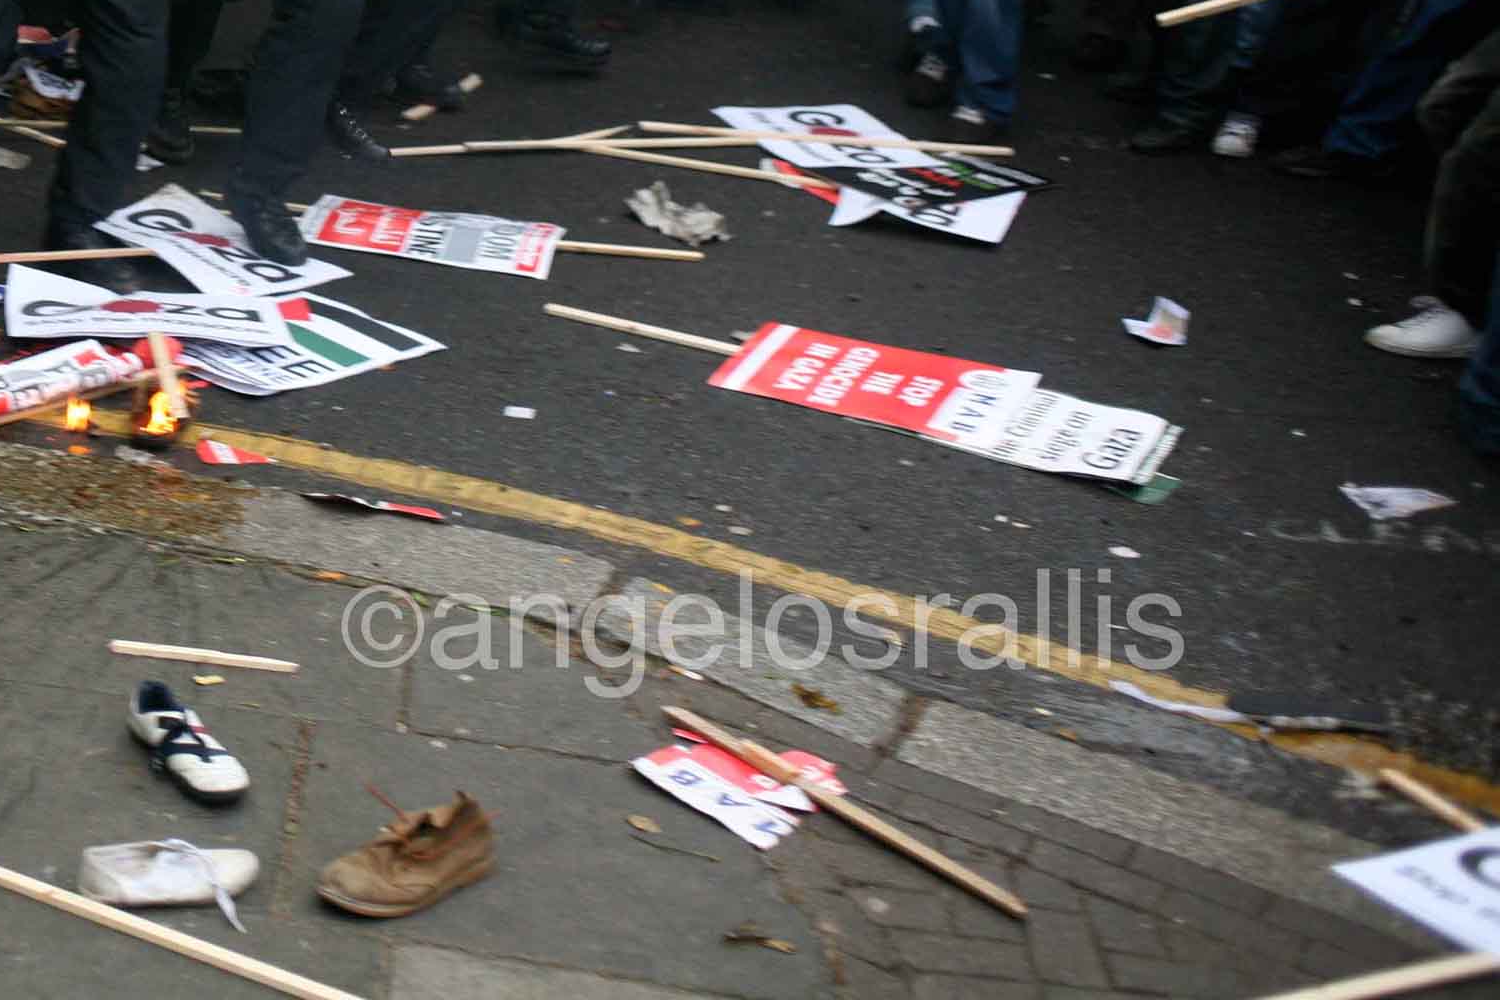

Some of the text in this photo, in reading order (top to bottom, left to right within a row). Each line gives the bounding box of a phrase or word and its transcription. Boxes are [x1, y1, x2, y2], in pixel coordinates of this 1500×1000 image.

[126, 208, 304, 283] Gza
[21, 299, 264, 323] Gza
[1080, 428, 1143, 470] Gaza
